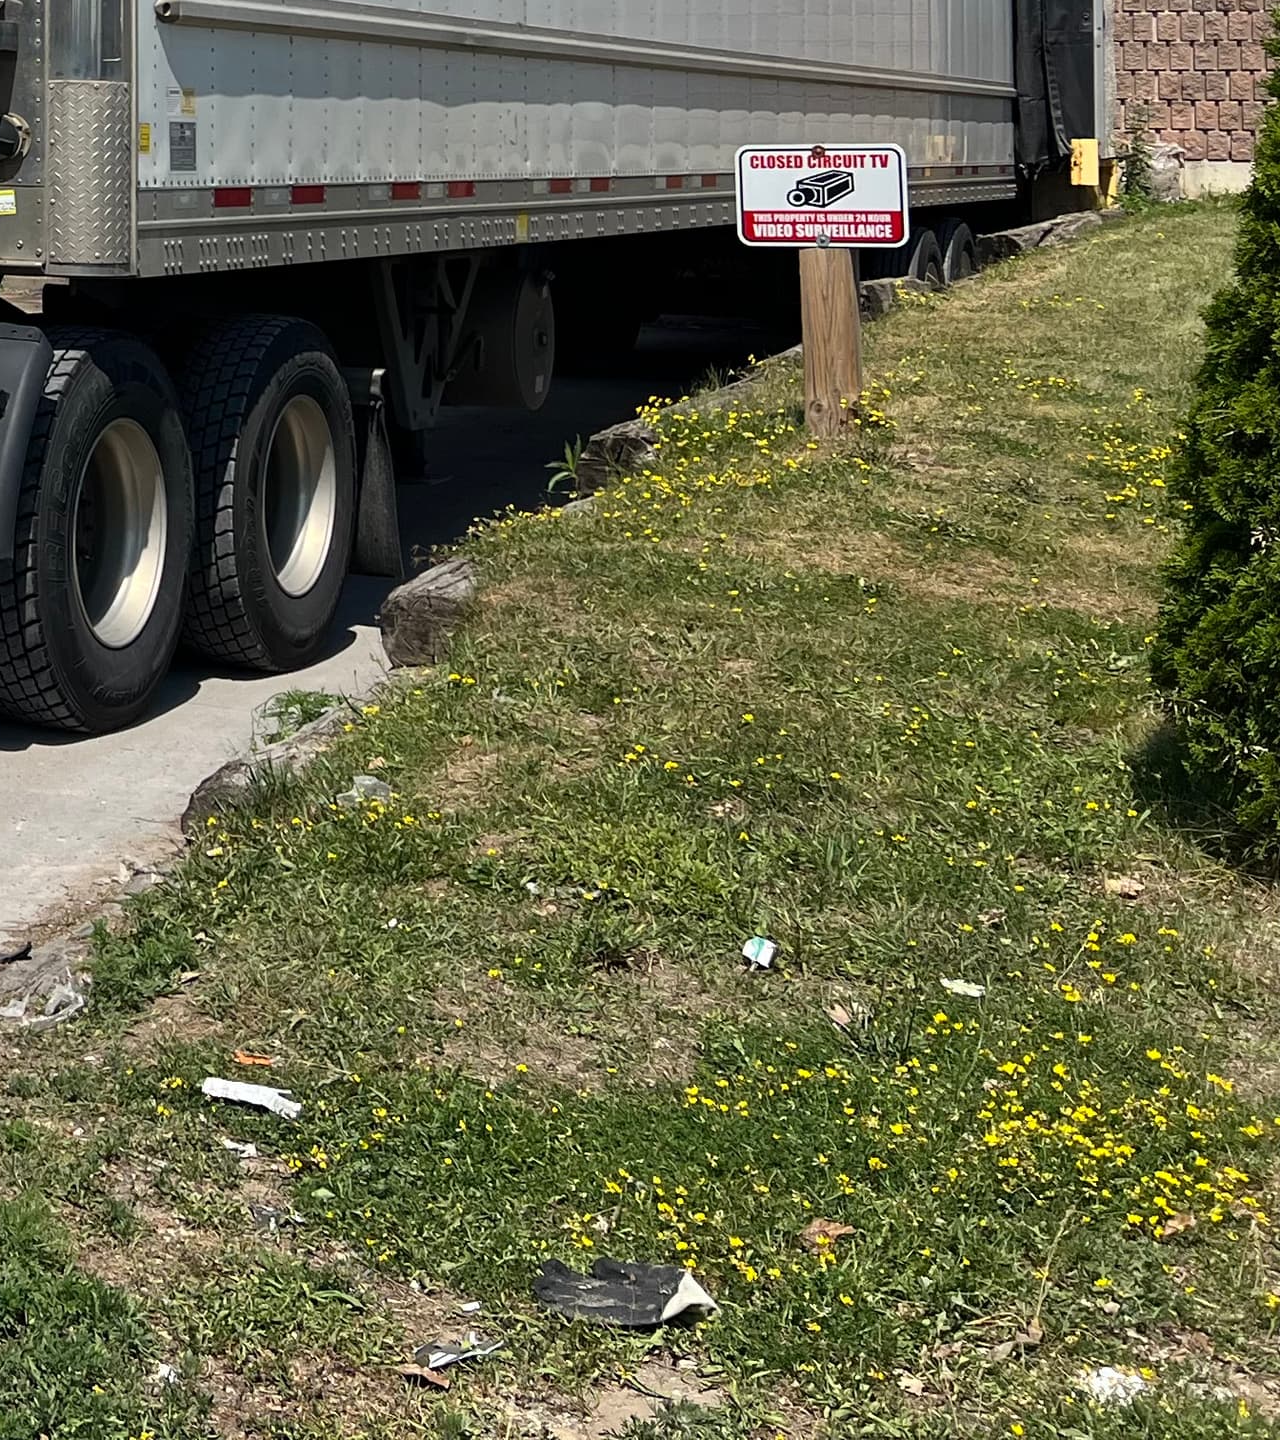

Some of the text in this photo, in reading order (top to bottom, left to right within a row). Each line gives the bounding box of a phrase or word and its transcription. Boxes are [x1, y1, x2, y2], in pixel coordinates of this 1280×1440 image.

[750, 154, 889, 169] CLOSED CIRCUIT TV
[753, 213, 772, 222] THIS
[773, 213, 816, 222] PROPERTY
[816, 213, 826, 222] IS
[855, 213, 866, 222] 24
[753, 223, 893, 238] VIDEO SURVEILLANCE
